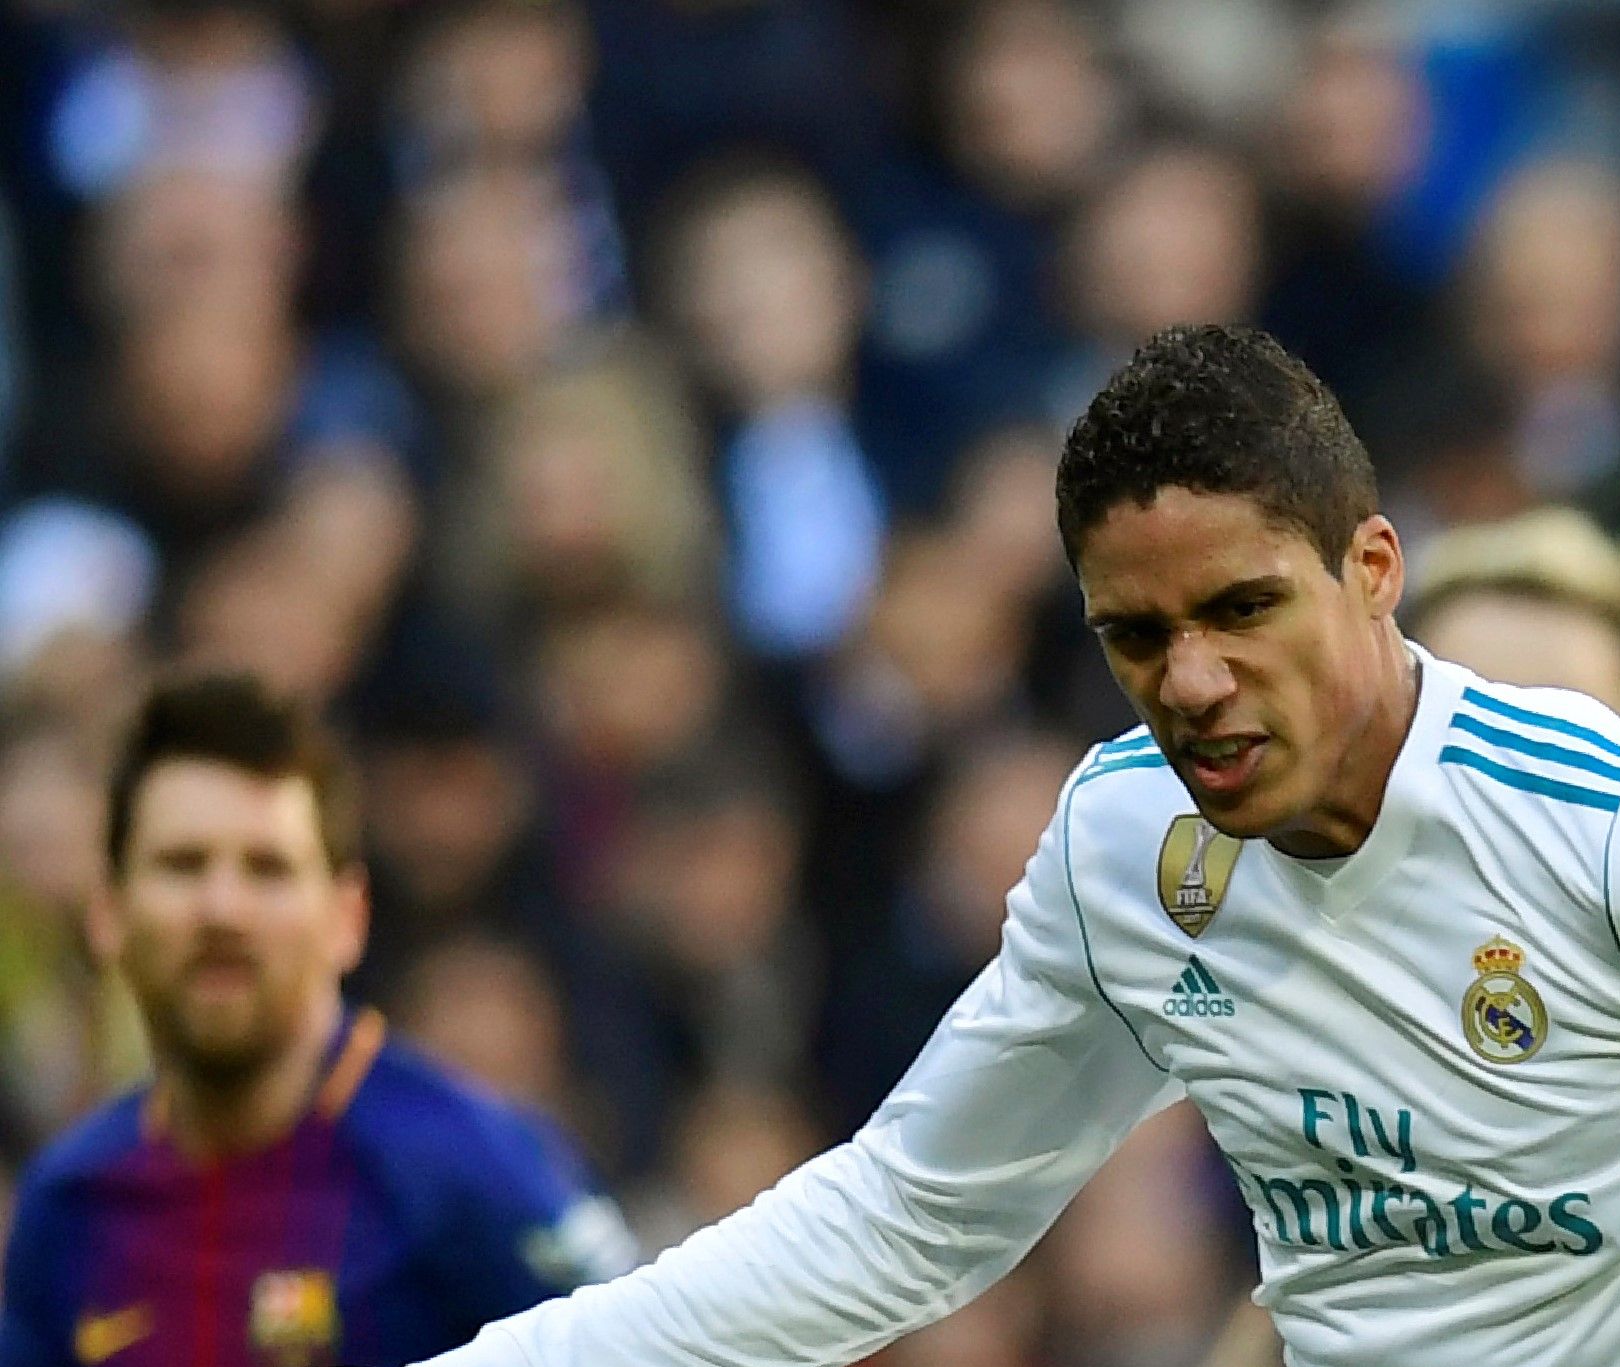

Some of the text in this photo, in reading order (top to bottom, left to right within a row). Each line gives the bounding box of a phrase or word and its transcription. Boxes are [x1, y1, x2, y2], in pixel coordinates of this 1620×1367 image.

[1163, 993, 1235, 1017] adidas
[1298, 1088, 1416, 1173] Fly
[1242, 1157, 1602, 1257] mirates
